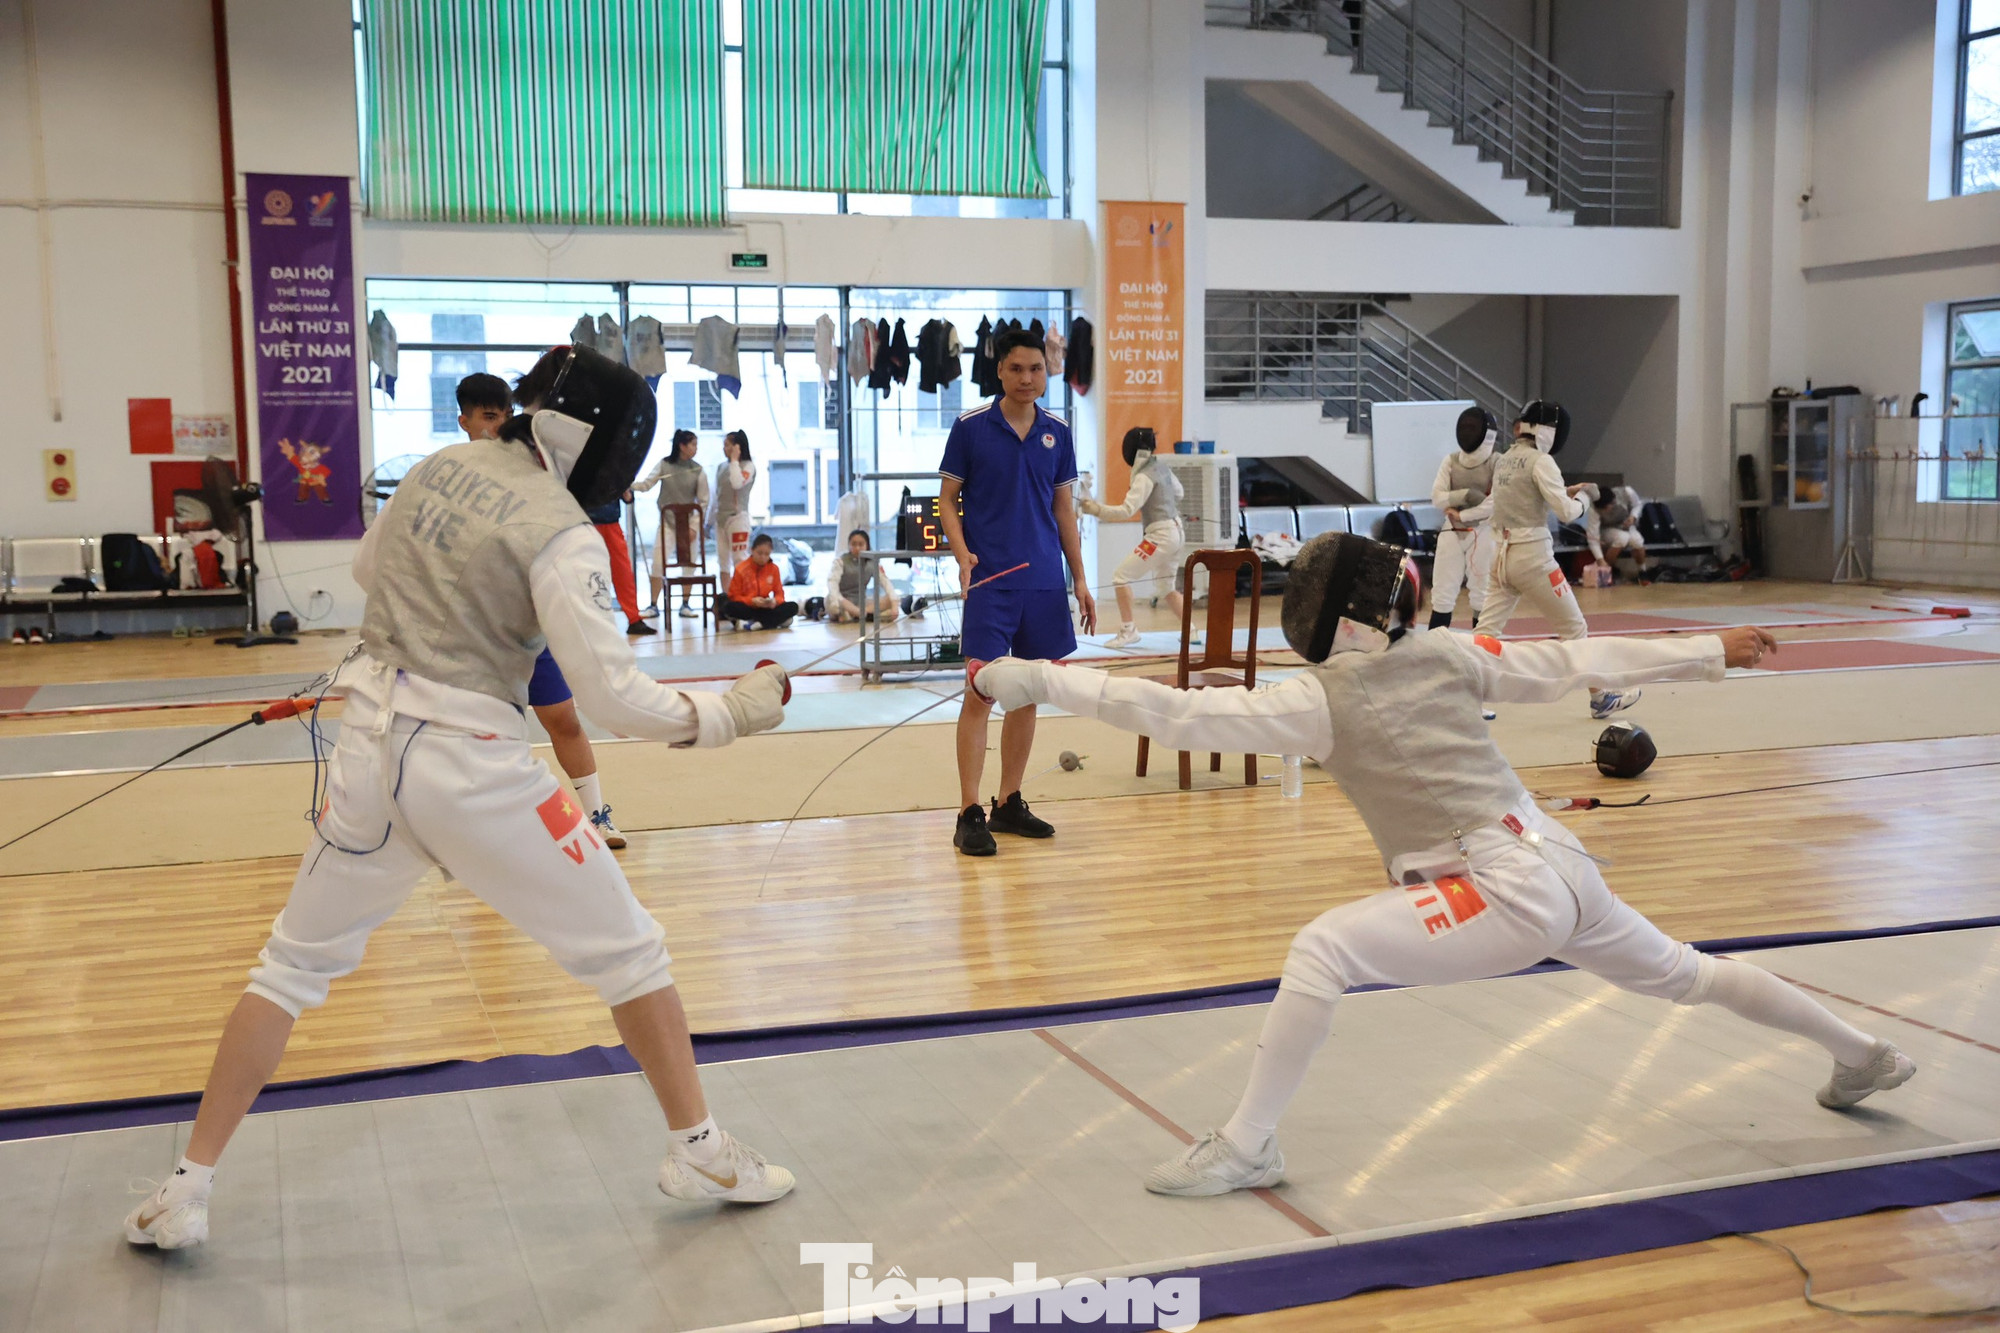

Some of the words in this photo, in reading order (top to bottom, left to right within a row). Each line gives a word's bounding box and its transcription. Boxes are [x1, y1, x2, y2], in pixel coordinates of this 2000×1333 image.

[270, 266, 299, 282] ĐẠI
[303, 264, 334, 282] HỘI
[334, 321, 349, 334] 31
[1166, 330, 1179, 341] 31
[260, 339, 303, 361] VIỆT
[307, 343, 351, 358] NAM
[1109, 346, 1141, 363] VIỆT
[1145, 350, 1179, 361] NAM
[281, 366, 332, 384] 2021
[1124, 369, 1163, 384] 2021
[413, 454, 528, 525] NGUYEN
[410, 499, 467, 553] VIE
[923, 525, 937, 550] 5
[1554, 584, 1569, 598] VI
[562, 827, 601, 865] VI
[1404, 883, 1452, 935] VIE
